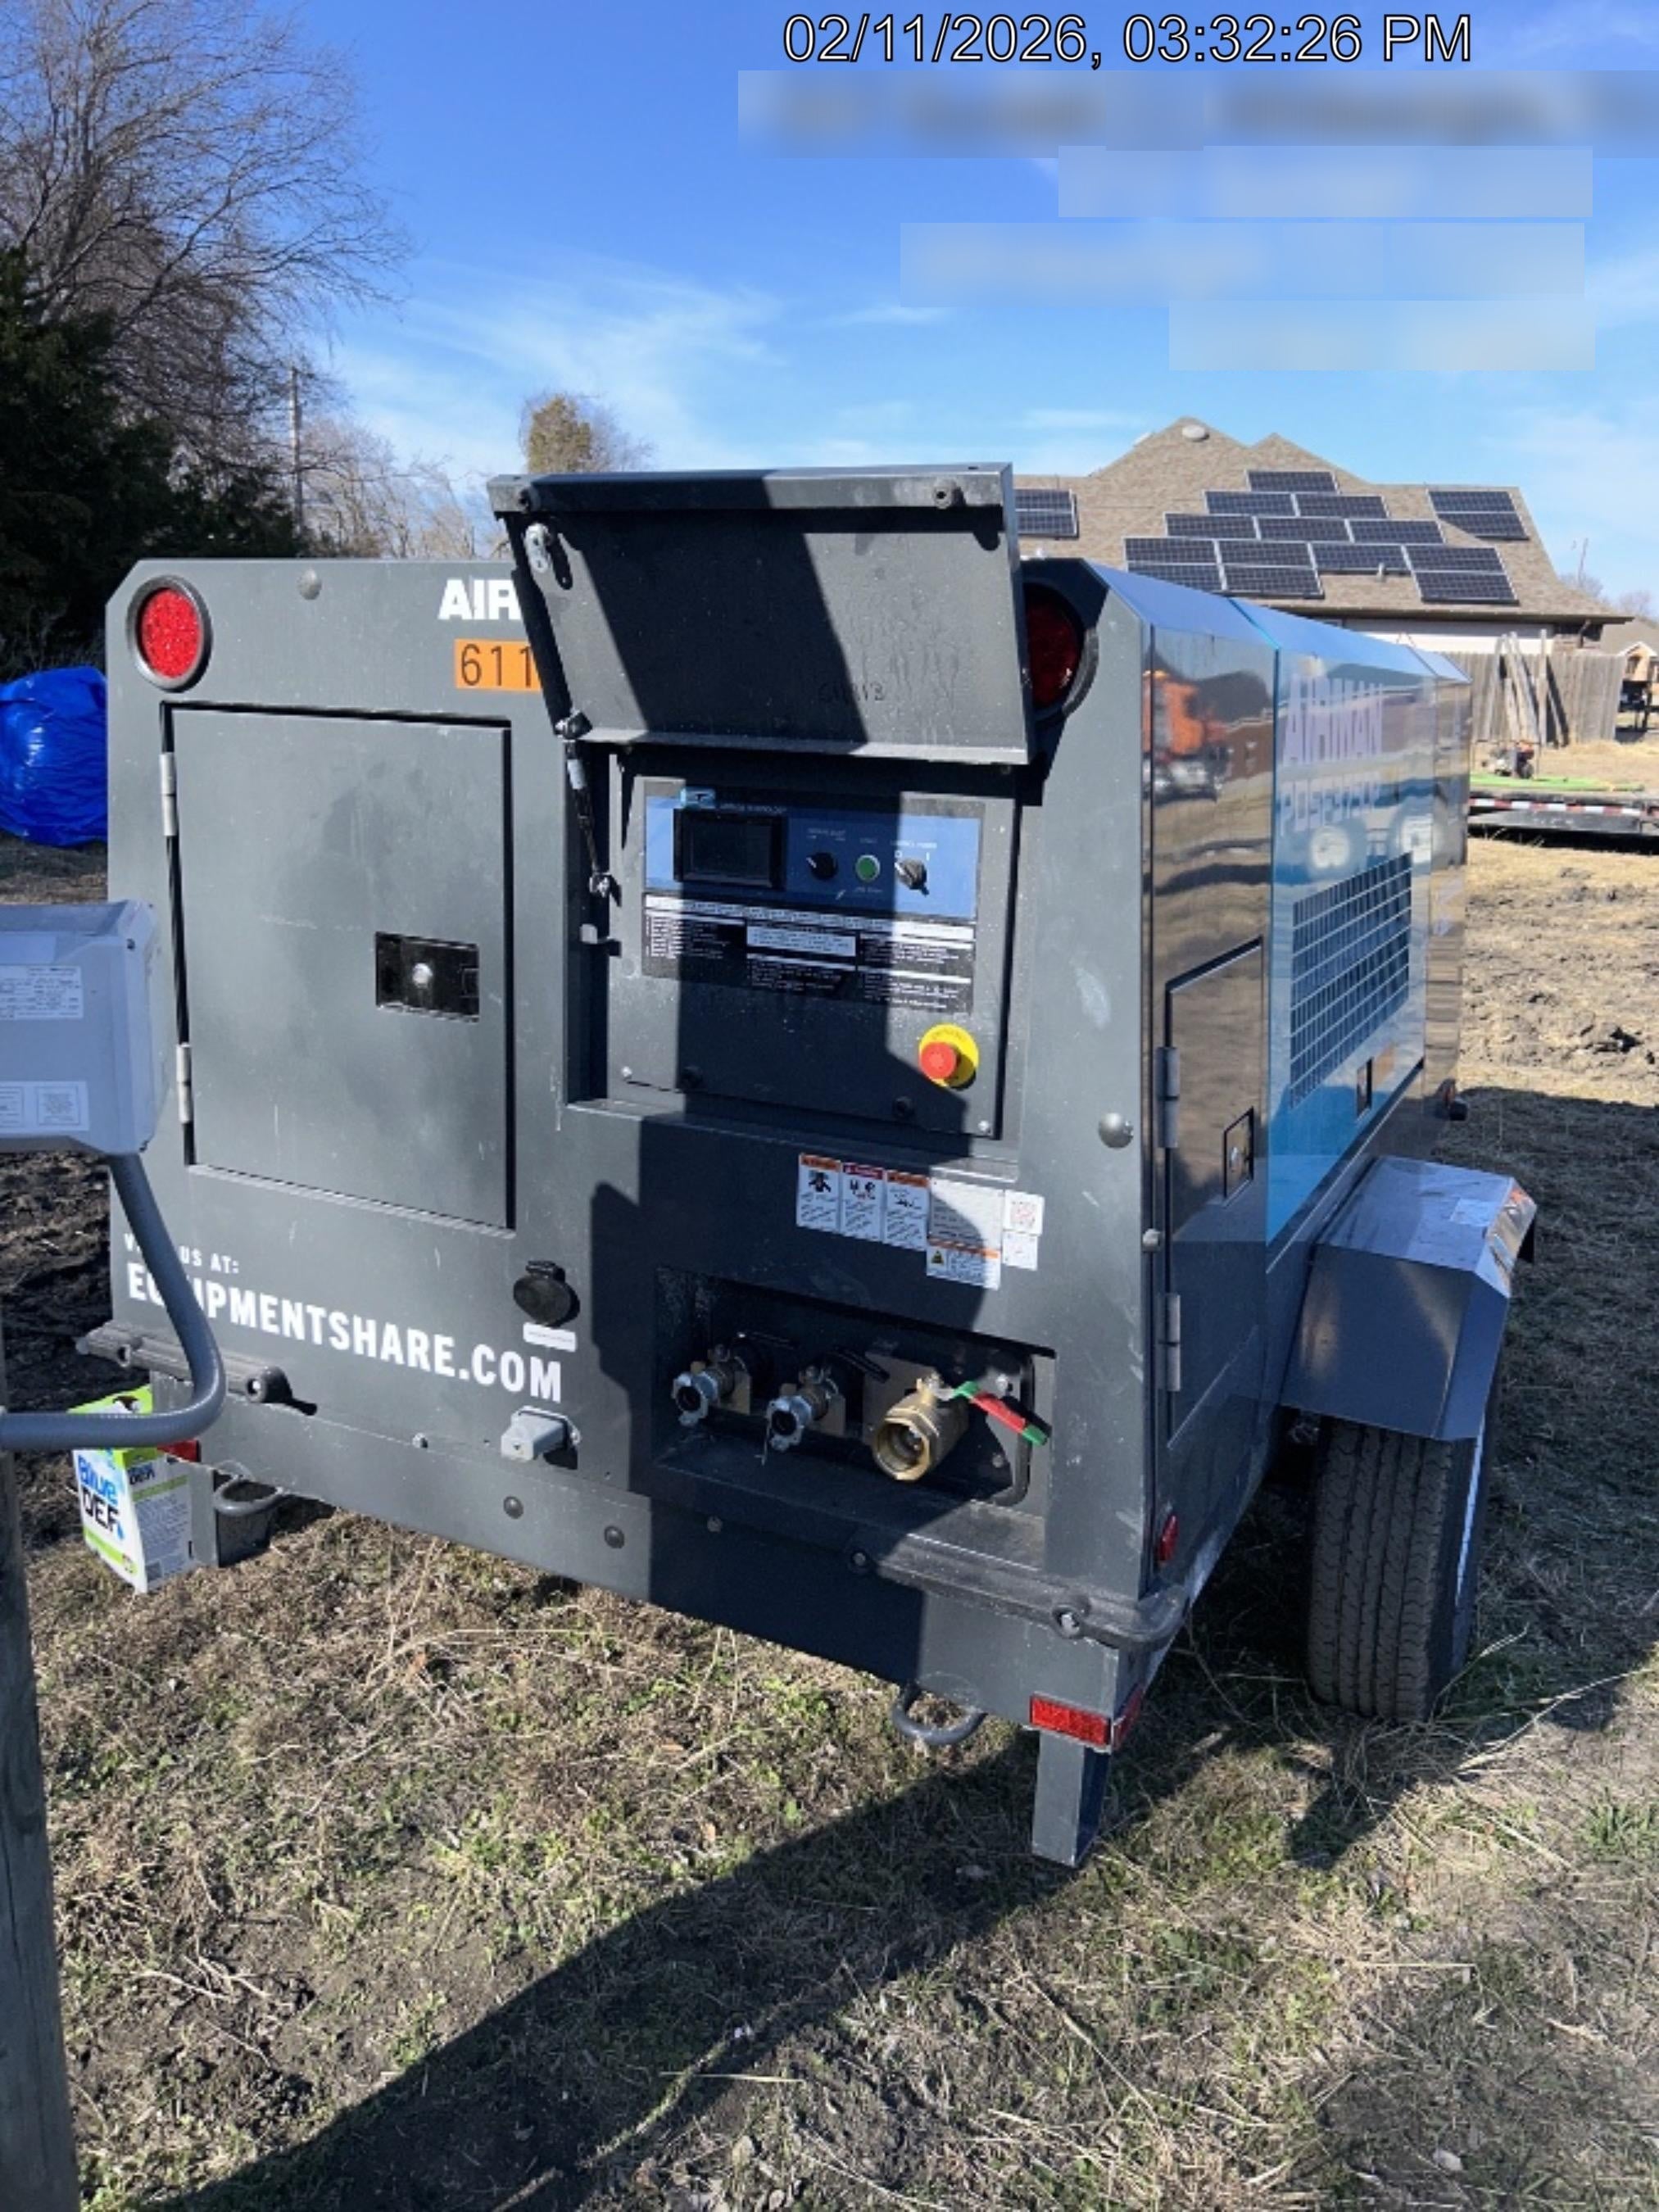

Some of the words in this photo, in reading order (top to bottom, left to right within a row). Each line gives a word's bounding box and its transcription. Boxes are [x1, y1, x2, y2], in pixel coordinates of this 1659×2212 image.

[460, 642, 533, 688] 611
[178, 1244, 203, 1267] US
[210, 1253, 239, 1274] AT:
[126, 1262, 563, 1404] EIPMENTSHARE.COM
[77, 1454, 118, 1507] Blue
[81, 1485, 120, 1532] DEF
